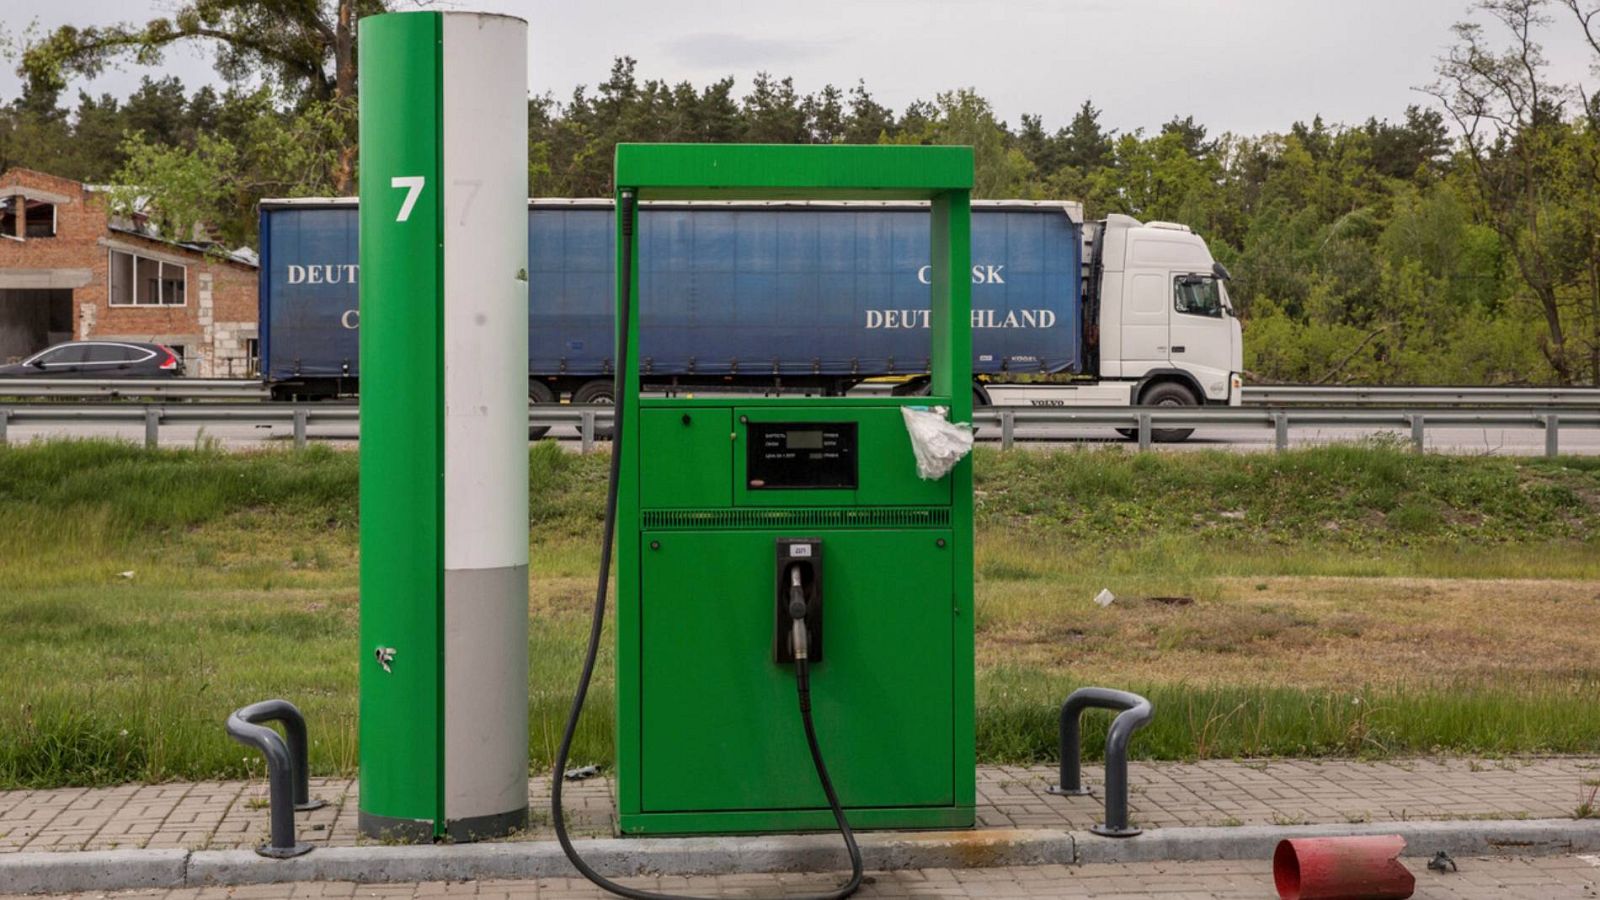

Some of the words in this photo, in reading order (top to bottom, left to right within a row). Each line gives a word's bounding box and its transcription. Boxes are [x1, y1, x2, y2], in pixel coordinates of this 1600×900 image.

[391, 176, 425, 222] 7
[287, 264, 360, 284] DEUT
[917, 264, 1005, 285] CSK
[341, 309, 360, 329] C
[865, 309, 1056, 329] DEUTHLAND
